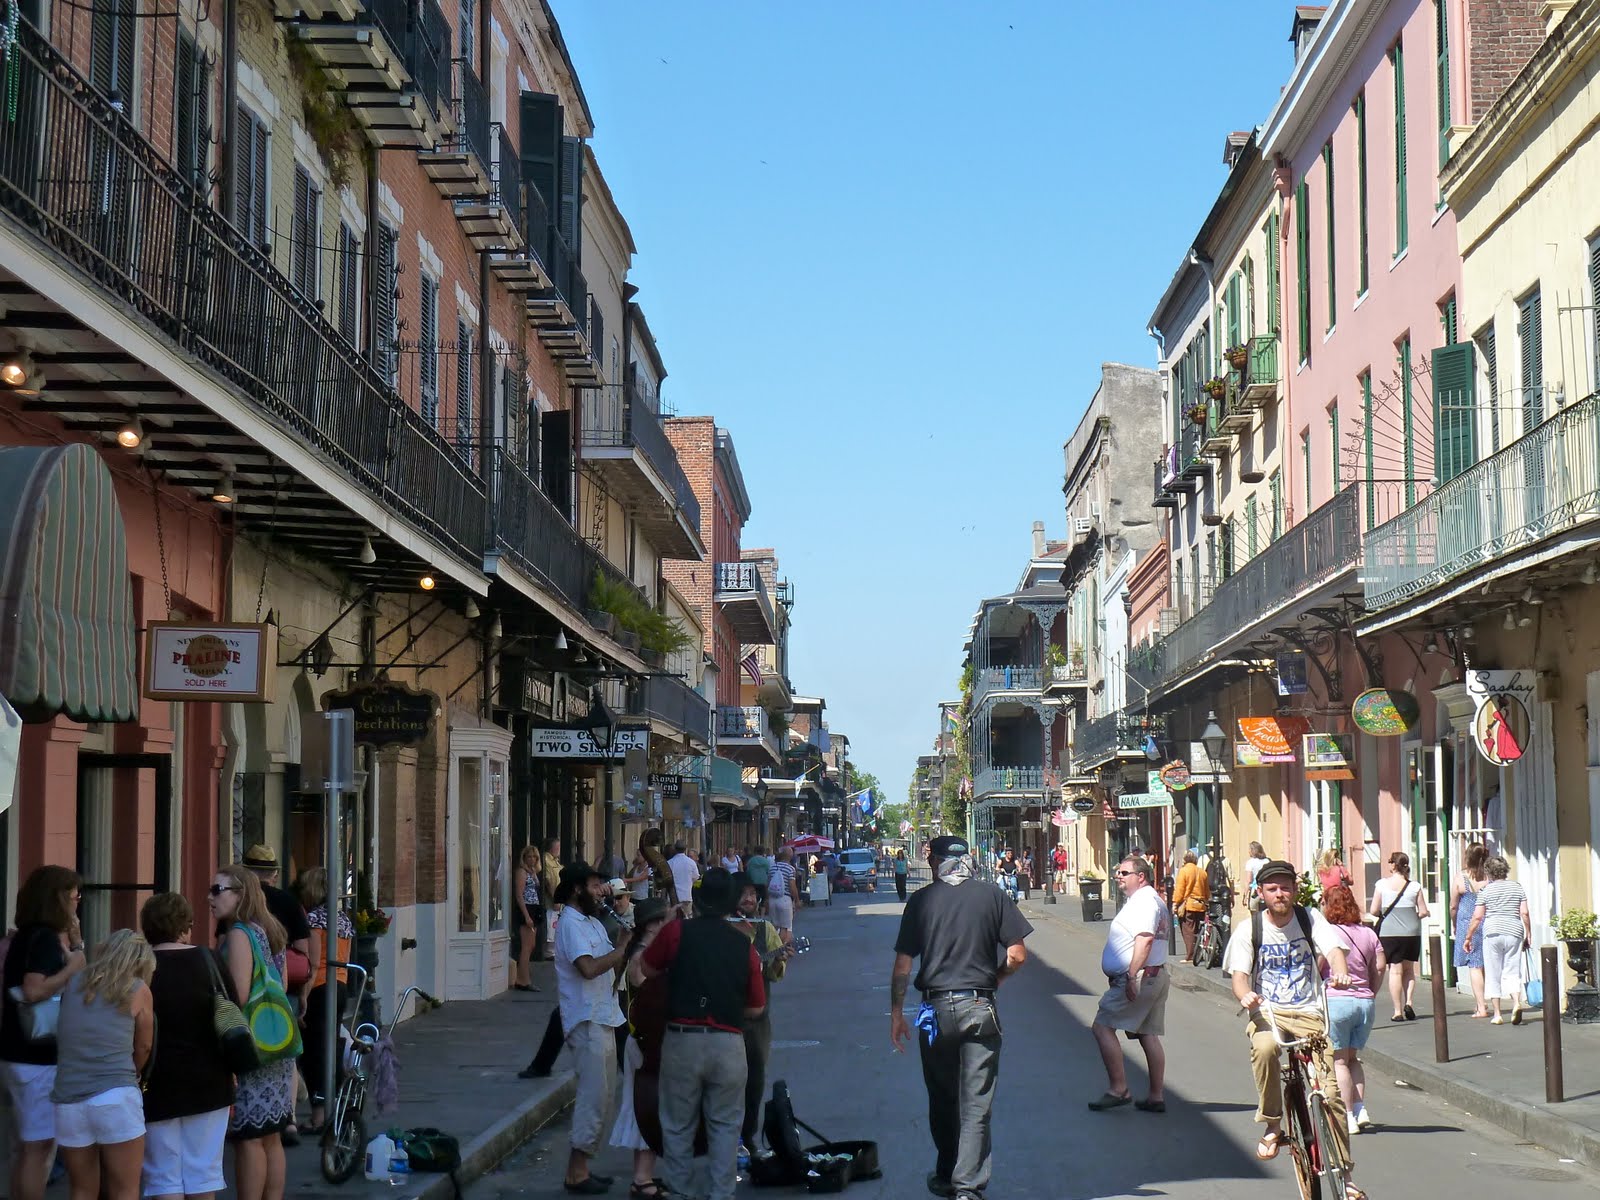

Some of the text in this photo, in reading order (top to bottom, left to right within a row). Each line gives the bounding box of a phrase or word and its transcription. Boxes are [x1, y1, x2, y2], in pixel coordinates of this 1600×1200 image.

[177, 637, 195, 645] NEW
[172, 650, 241, 666] PRALINE
[185, 679, 227, 688] SOLD HERE
[1469, 671, 1535, 703] Sashay
[362, 695, 401, 713] Great
[355, 717, 424, 732] pectations
[622, 731, 636, 742] of
[536, 741, 645, 753] TWO SIERS
[651, 773, 678, 784] Royal
